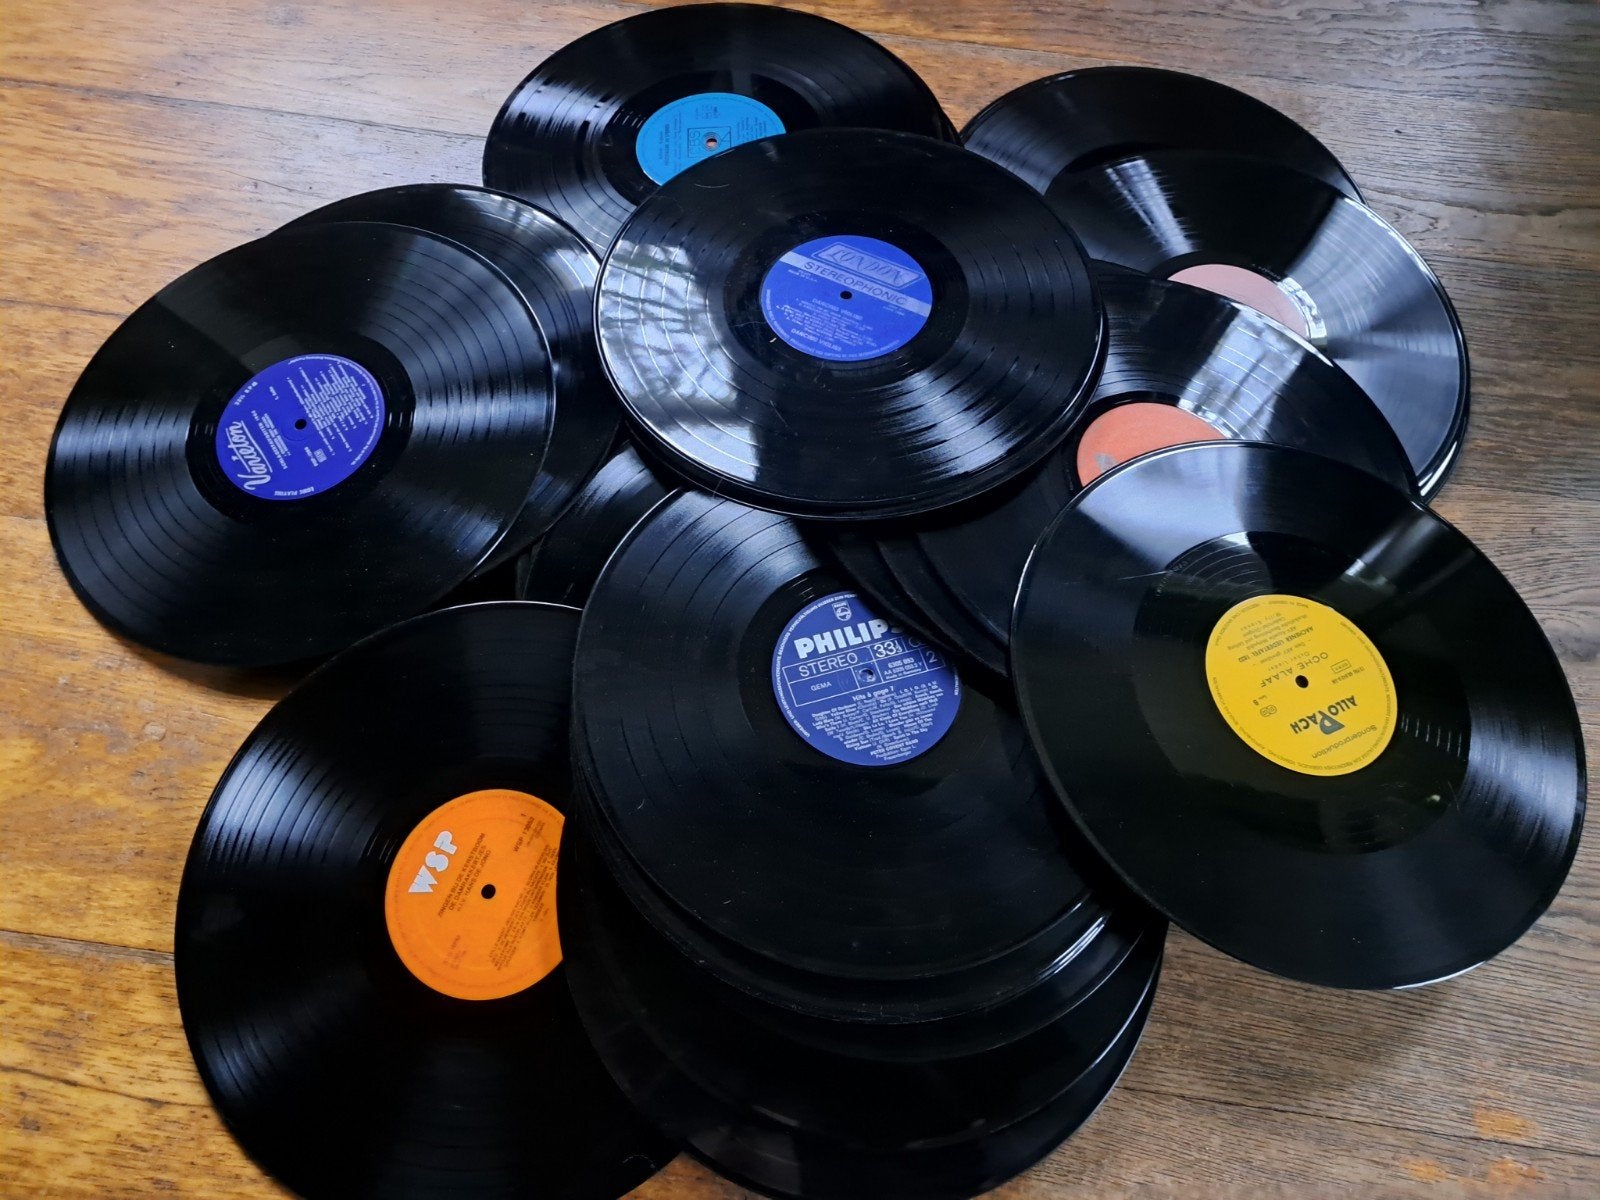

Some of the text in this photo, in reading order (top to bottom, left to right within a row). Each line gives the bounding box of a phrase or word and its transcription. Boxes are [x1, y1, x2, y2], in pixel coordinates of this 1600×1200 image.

[827, 248, 908, 286] LONDON
[804, 261, 908, 305] STEREOPHONIC
[227, 421, 270, 490] Varieton
[1286, 626, 1314, 642] AACHENER
[926, 650, 938, 663] 2
[1251, 639, 1284, 657] LIEDERTAFEL
[798, 652, 858, 678] STEREO
[1298, 652, 1328, 670] OCHE
[810, 681, 832, 692] GEMA
[1260, 667, 1293, 687] ALAAF
[852, 693, 866, 701] Hits
[872, 687, 889, 697] gogo
[1311, 724, 1377, 759] Sonderproduktion
[408, 830, 458, 893] WSP
[461, 831, 485, 872] KERSTBOOM
